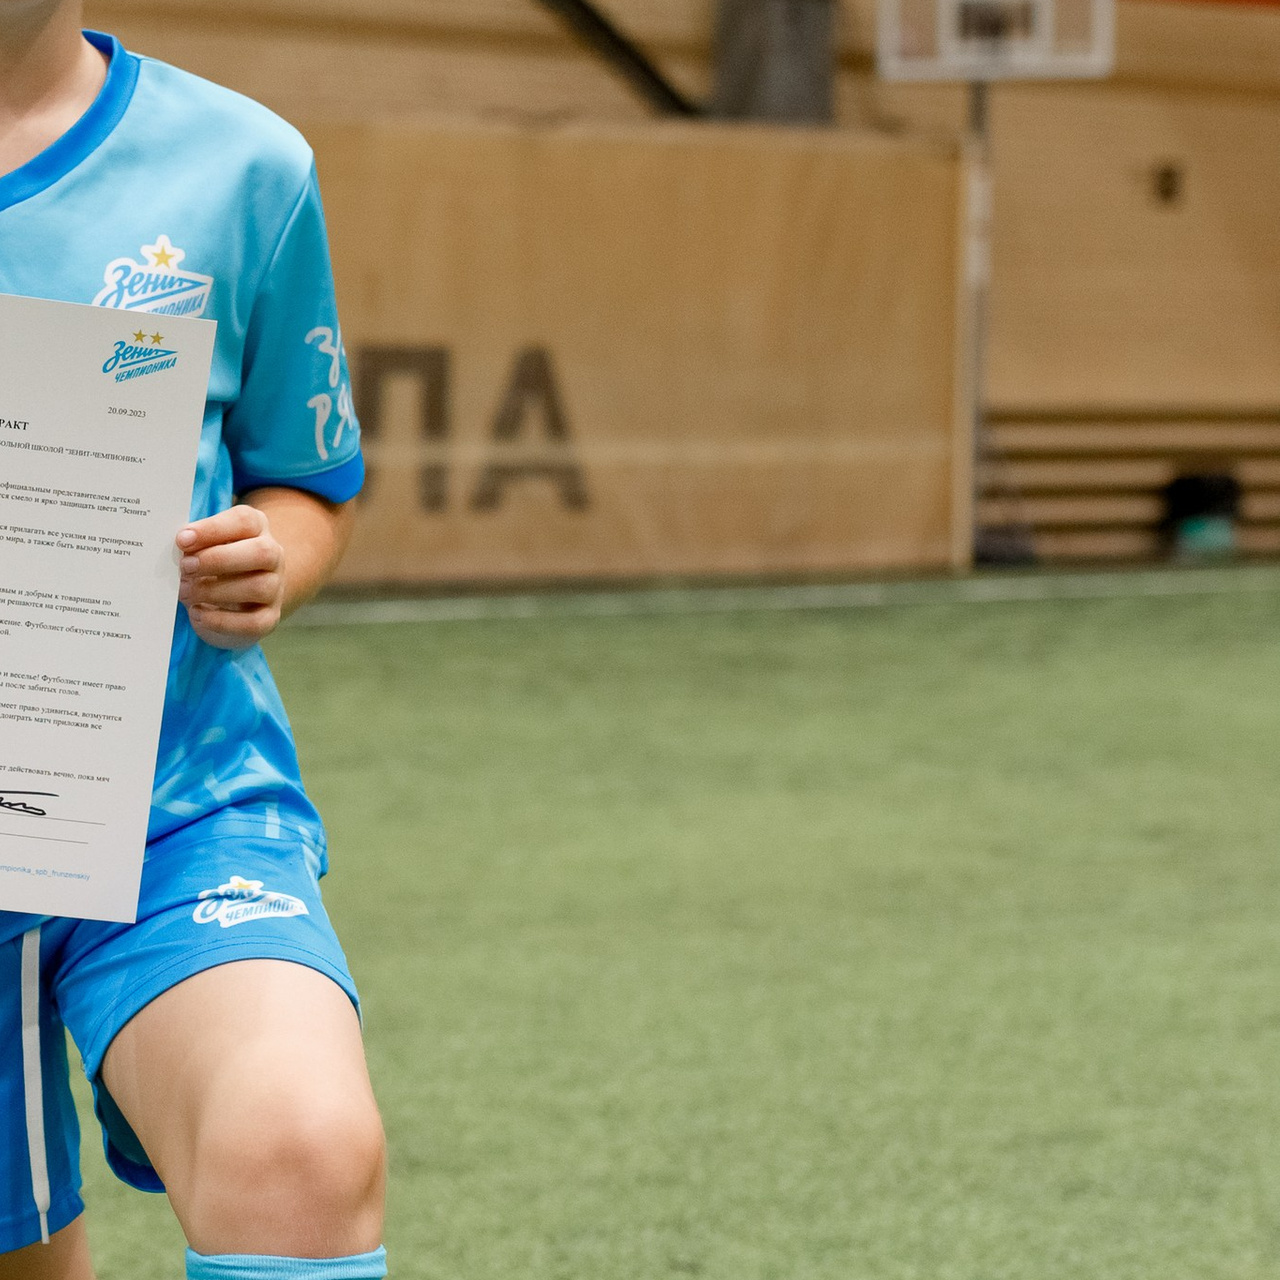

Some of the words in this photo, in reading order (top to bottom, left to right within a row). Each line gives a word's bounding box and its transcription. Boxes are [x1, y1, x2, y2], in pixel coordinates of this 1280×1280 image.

[102, 340, 179, 374] Зенит
[115, 357, 178, 383] ЧЕМПИОНИКА
[107, 406, 146, 418] 20.09.2023
[31, 444, 64, 454] ШКОЛОЙ
[0, 481, 51, 494] официальным
[52, 489, 110, 501] представителем
[111, 496, 141, 505] детской
[10, 494, 33, 502] смело
[59, 500, 96, 510] защищать
[97, 505, 118, 513] цвета
[9, 525, 46, 535] прилагать
[60, 532, 86, 540] усилия
[98, 536, 143, 547] тренировках
[33, 539, 55, 547] также
[24, 589, 53, 599] добрым
[61, 594, 101, 605] товарищам
[54, 605, 89, 614] странные
[90, 609, 120, 617] свистки.
[24, 620, 64, 632] Футболист
[65, 625, 101, 636] обязуется
[102, 631, 132, 640] уважать
[5, 682, 26, 690] после
[28, 683, 57, 694] забитых
[58, 688, 80, 696] голов.
[41, 674, 81, 686] Футболист
[104, 683, 126, 691] право
[18, 704, 40, 712] право
[7, 765, 52, 776] действовать
